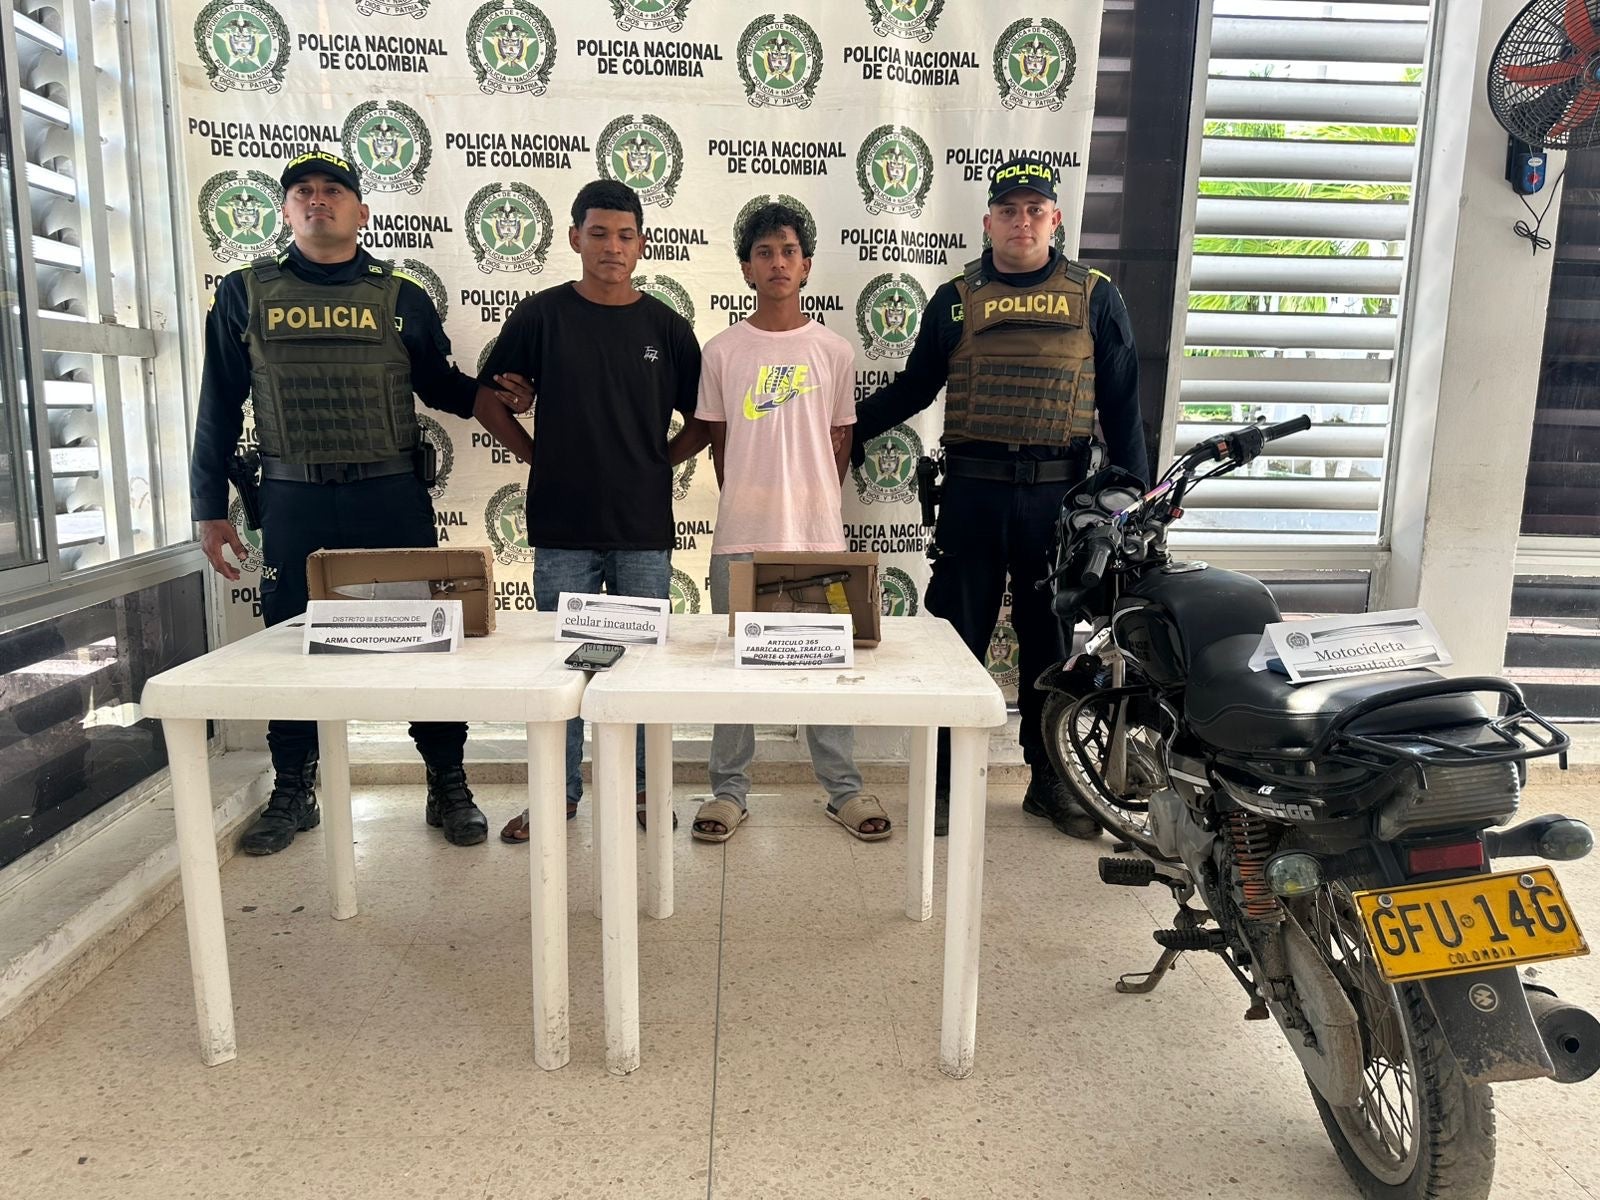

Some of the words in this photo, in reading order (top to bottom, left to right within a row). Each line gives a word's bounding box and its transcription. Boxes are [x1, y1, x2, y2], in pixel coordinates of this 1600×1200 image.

[395, 4, 419, 13] PATRIA
[653, 18, 675, 28] PATRIA
[298, 33, 361, 52] POLICIA
[365, 35, 448, 55] NACIONAL
[577, 39, 640, 57] POLICIA
[644, 41, 723, 60] NACIONAL
[319, 52, 340, 70] DE
[344, 53, 429, 73] COLOMBIA
[843, 46, 901, 64] POLICIA
[905, 50, 980, 68] NACIONAL
[597, 57, 618, 74] DE
[622, 58, 704, 77] COLOMBIA
[862, 63, 882, 80] DE
[887, 64, 960, 85] COLOMBIA
[188, 117, 255, 140] POLICIA
[260, 124, 341, 142] NACIONAL
[211, 139, 233, 157] DE
[238, 141, 321, 159] COLOMBIA
[445, 133, 507, 150] POLICIA
[511, 134, 590, 152] NACIONAL
[708, 139, 768, 157] POLICIA
[771, 141, 846, 158] NACIONAL
[466, 151, 486, 167] DE
[490, 151, 572, 169] COLOMBIA
[946, 149, 1004, 164] POLICIA
[727, 157, 747, 173] DE
[751, 158, 828, 175] COLOMBIA
[964, 166, 982, 181] DE
[373, 214, 453, 233] NACIONAL
[645, 227, 709, 245] ACIONAL
[841, 229, 897, 245] POLICIA
[901, 230, 967, 249] NACIONAL
[640, 245, 690, 261] OMBIA
[859, 246, 878, 261] DE
[882, 246, 948, 265] COLOMBIA
[461, 290, 520, 305] POLICIA
[711, 295, 757, 310] POLICI
[801, 295, 844, 311] IONAL
[984, 294, 1070, 319] POLICIA
[267, 306, 377, 330] POLICIA
[481, 307, 500, 322] DE
[855, 371, 889, 386] LICIA
[492, 449, 511, 464] DE
[674, 521, 713, 535] IONAL
[844, 524, 886, 539] OLICIA
[849, 539, 867, 552] DE
[494, 582, 530, 596] LICIA
[565, 615, 601, 627] celular
[603, 617, 656, 632] incautado
[325, 636, 349, 644] ARMA
[1314, 640, 1406, 662] Motocicleta
[1371, 899, 1464, 956] GFU
[1473, 885, 1568, 943] 14G
[1448, 946, 1517, 965] COLOMBIA
